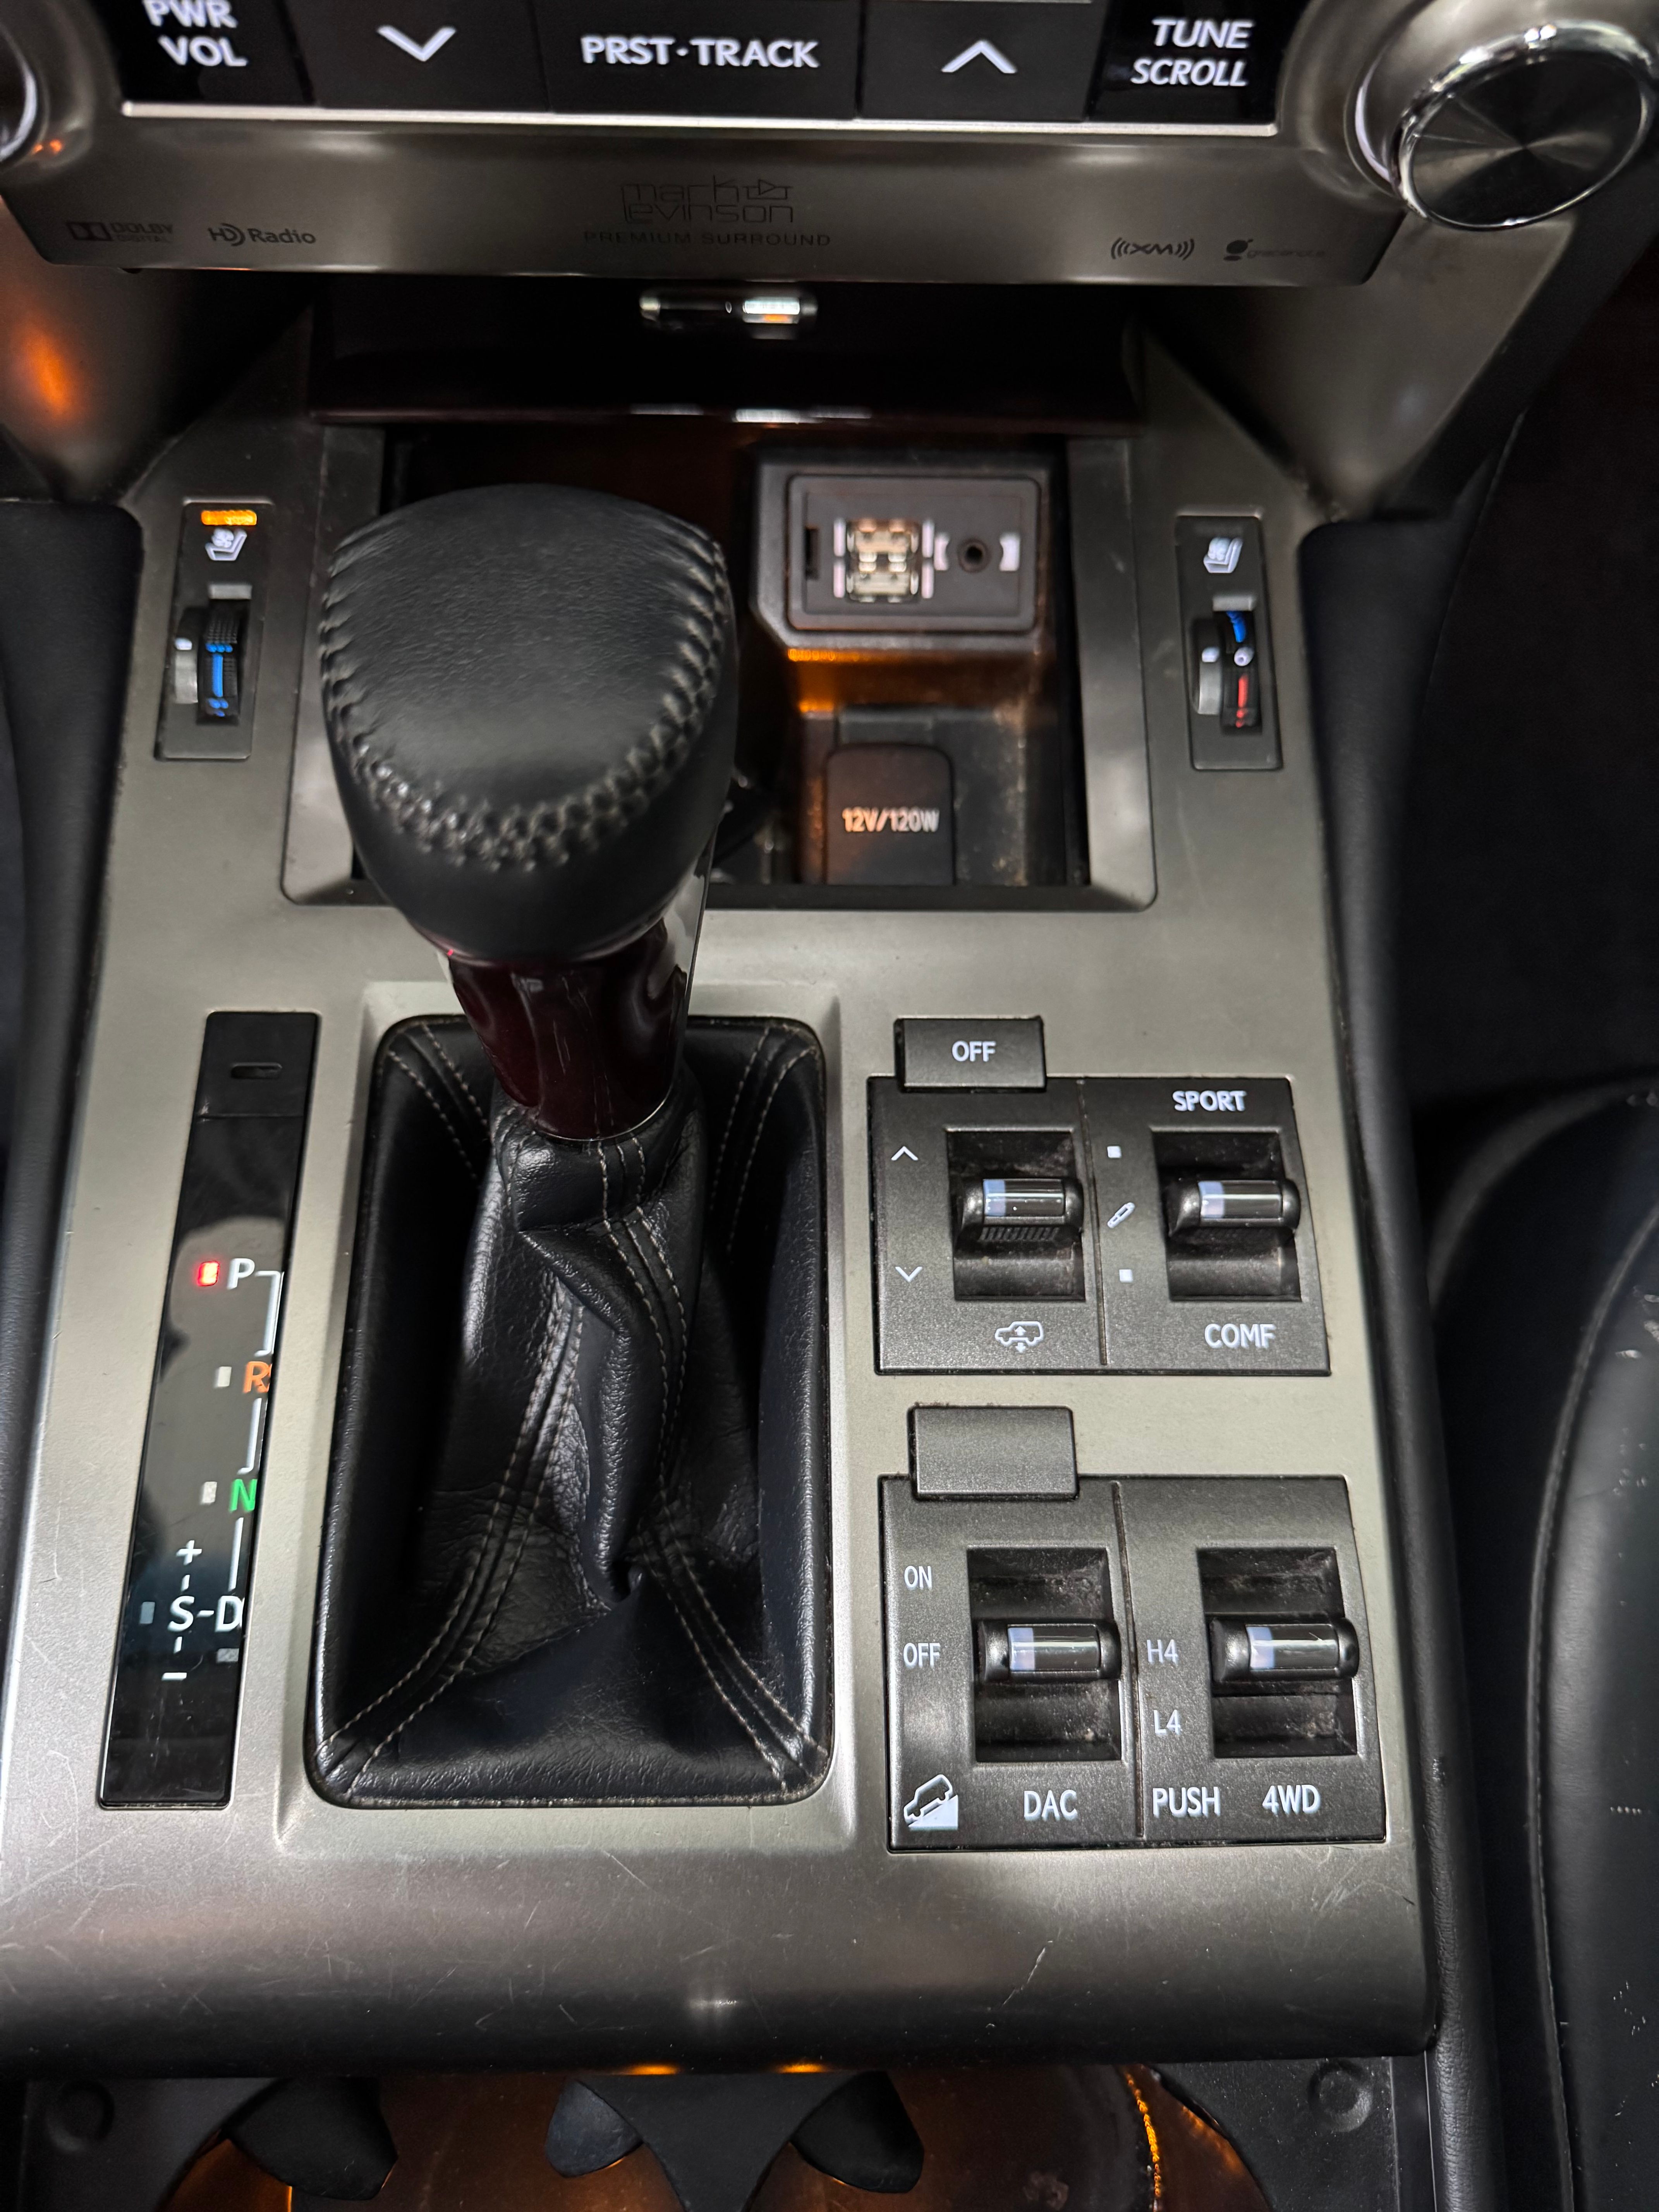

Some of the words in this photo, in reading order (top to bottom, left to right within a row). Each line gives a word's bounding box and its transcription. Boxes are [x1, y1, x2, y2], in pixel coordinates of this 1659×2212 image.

[142, 0, 239, 27] PWR
[1152, 18, 1255, 48] TUNE
[158, 34, 248, 66] VOL
[1130, 58, 1249, 86] SCROLL
[110, 223, 173, 234] DOLBY
[208, 224, 244, 245] HD
[247, 228, 316, 244] Radio
[584, 230, 690, 244] PREMIUM
[702, 233, 830, 246] SURROUND
[842, 807, 940, 832] 12V/120W
[952, 1040, 996, 1062] OFF
[1172, 1091, 1247, 1111] SPORT
[227, 1258, 255, 1290] P
[1204, 1324, 1276, 1349] COMF
[242, 1361, 272, 1393] R
[229, 1479, 258, 1512] N
[904, 1566, 932, 1589] ON
[903, 1642, 940, 1669] OFF
[1147, 1639, 1178, 1664] H4
[1154, 1709, 1182, 1735] L4
[1024, 1790, 1078, 1821] DAC
[1152, 1786, 1221, 1818] PUSH
[1262, 1784, 1320, 1815] 4WD
